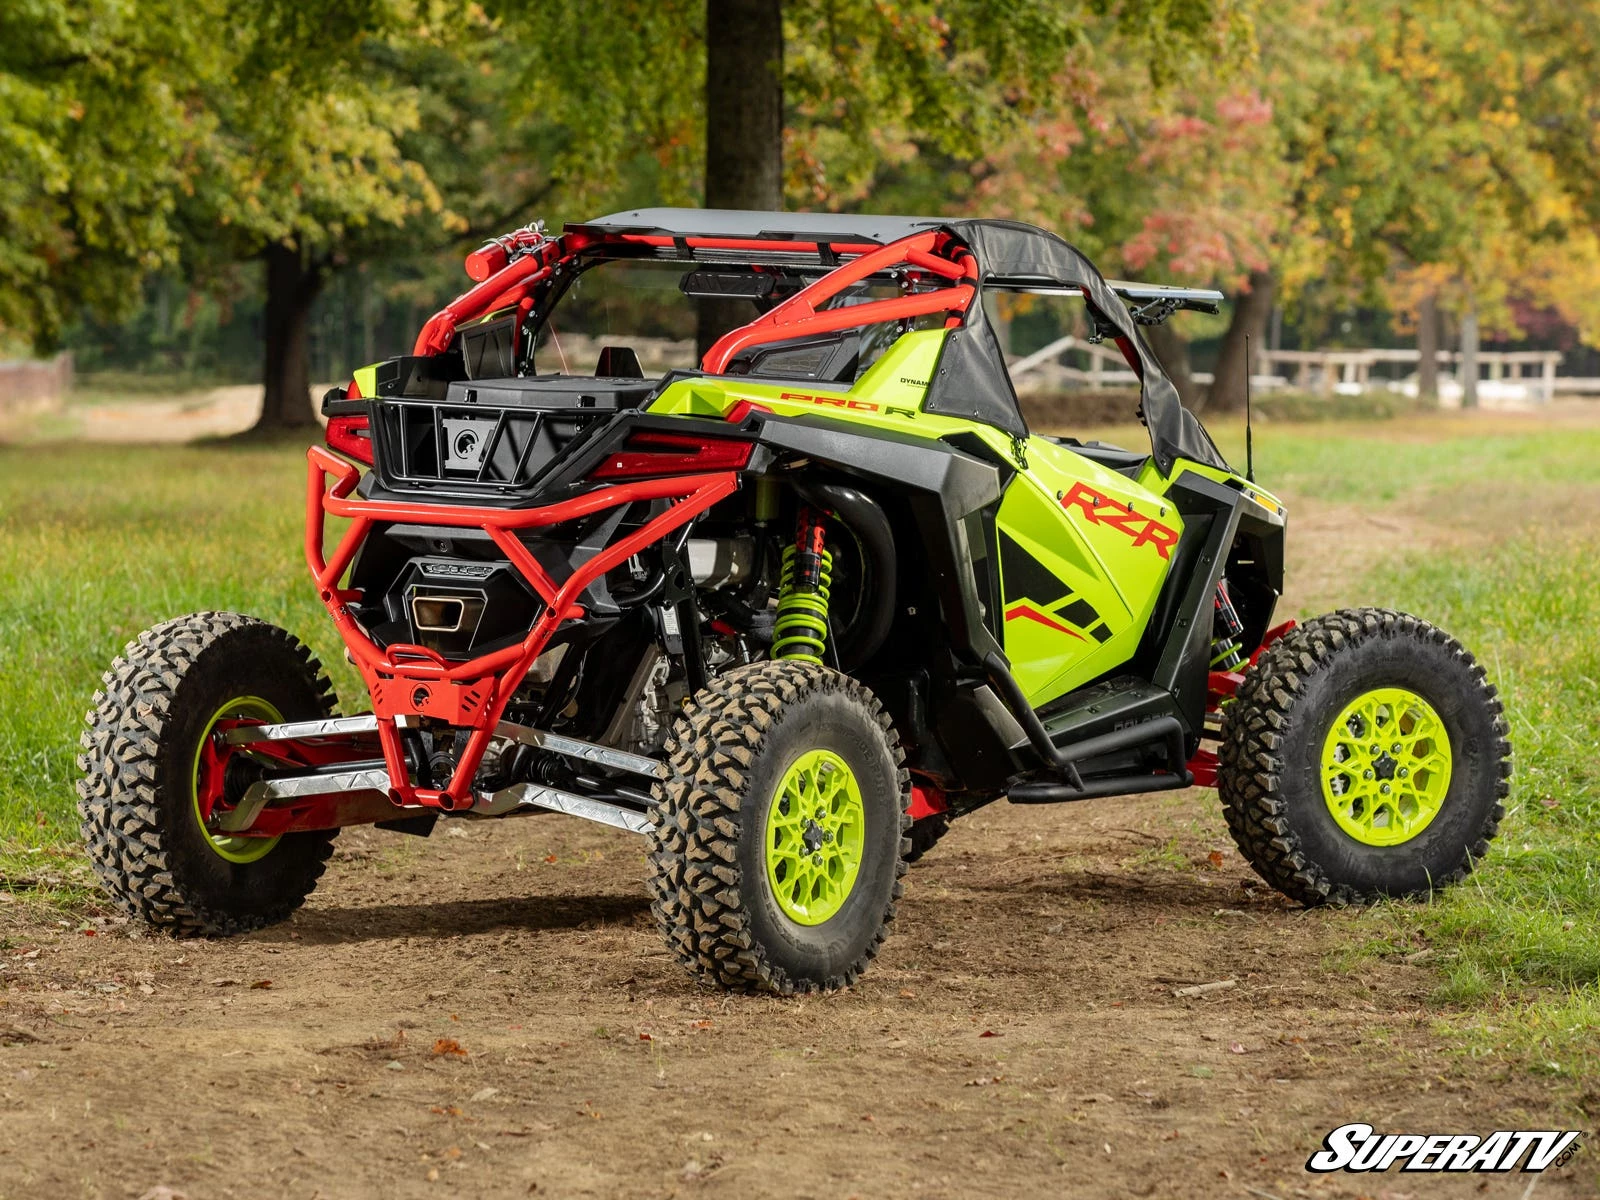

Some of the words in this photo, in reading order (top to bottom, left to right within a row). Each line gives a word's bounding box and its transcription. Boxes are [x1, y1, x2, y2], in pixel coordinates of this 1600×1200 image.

[780, 392, 879, 412] PRO
[885, 405, 916, 420] R
[1060, 481, 1179, 561] RZR
